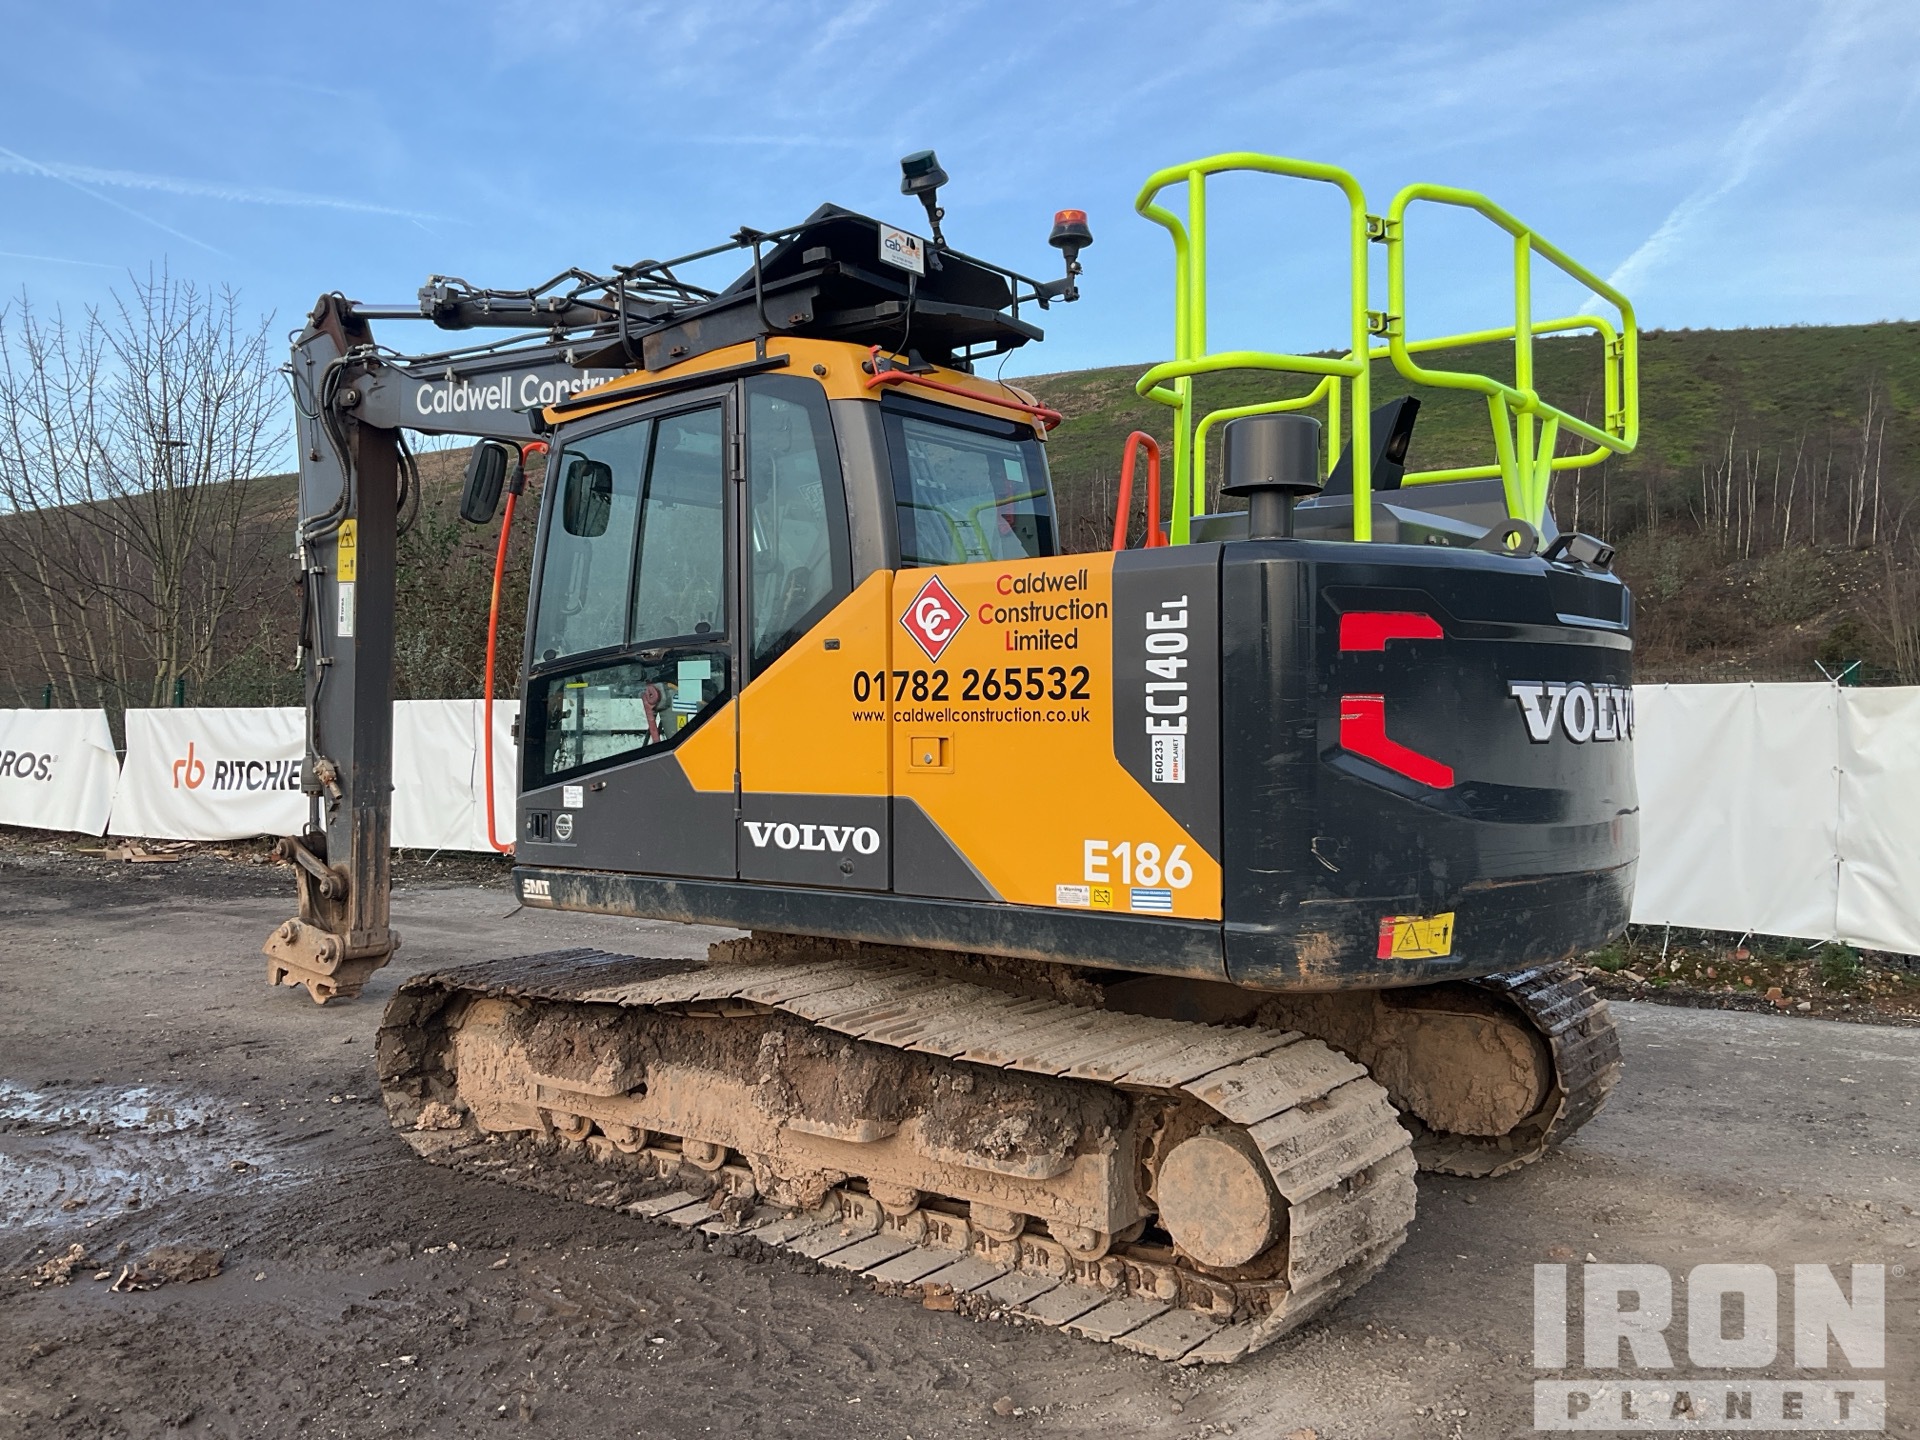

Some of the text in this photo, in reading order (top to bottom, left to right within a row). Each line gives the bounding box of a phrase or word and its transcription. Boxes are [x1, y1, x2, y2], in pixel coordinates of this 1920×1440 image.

[416, 376, 512, 415] Caldwell
[996, 569, 1088, 596] Caldwell
[978, 598, 1108, 625] Construction
[1006, 628, 1078, 651] Limited
[853, 666, 1091, 702] 01782 265532
[1509, 681, 1635, 744] VOLV
[0, 750, 52, 781] ROS.
[212, 760, 302, 791] RITCHIE
[1154, 739, 1164, 782] E60233
[744, 821, 880, 854] VOLVO
[1084, 839, 1193, 889] E186
[523, 878, 550, 895] SMT
